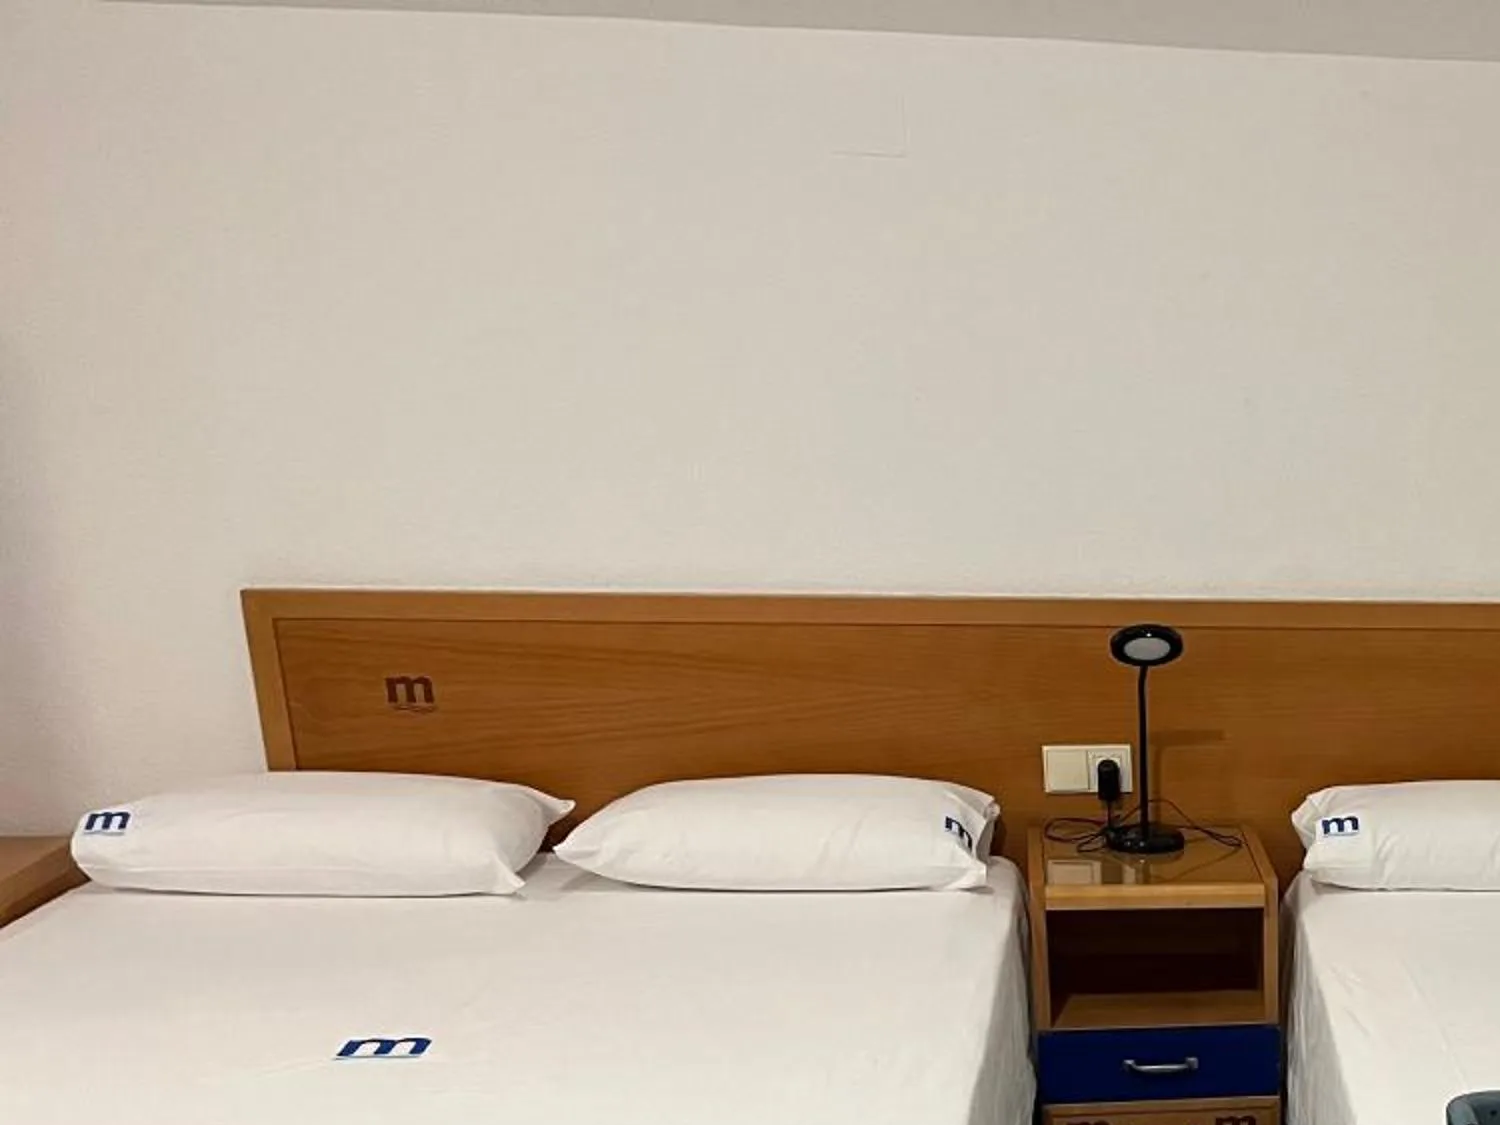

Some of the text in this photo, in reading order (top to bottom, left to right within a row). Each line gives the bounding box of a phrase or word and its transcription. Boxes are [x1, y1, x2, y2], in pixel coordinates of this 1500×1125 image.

[385, 676, 434, 704] m
[84, 811, 130, 831] m
[1321, 815, 1359, 835] m
[336, 1037, 432, 1057] m
